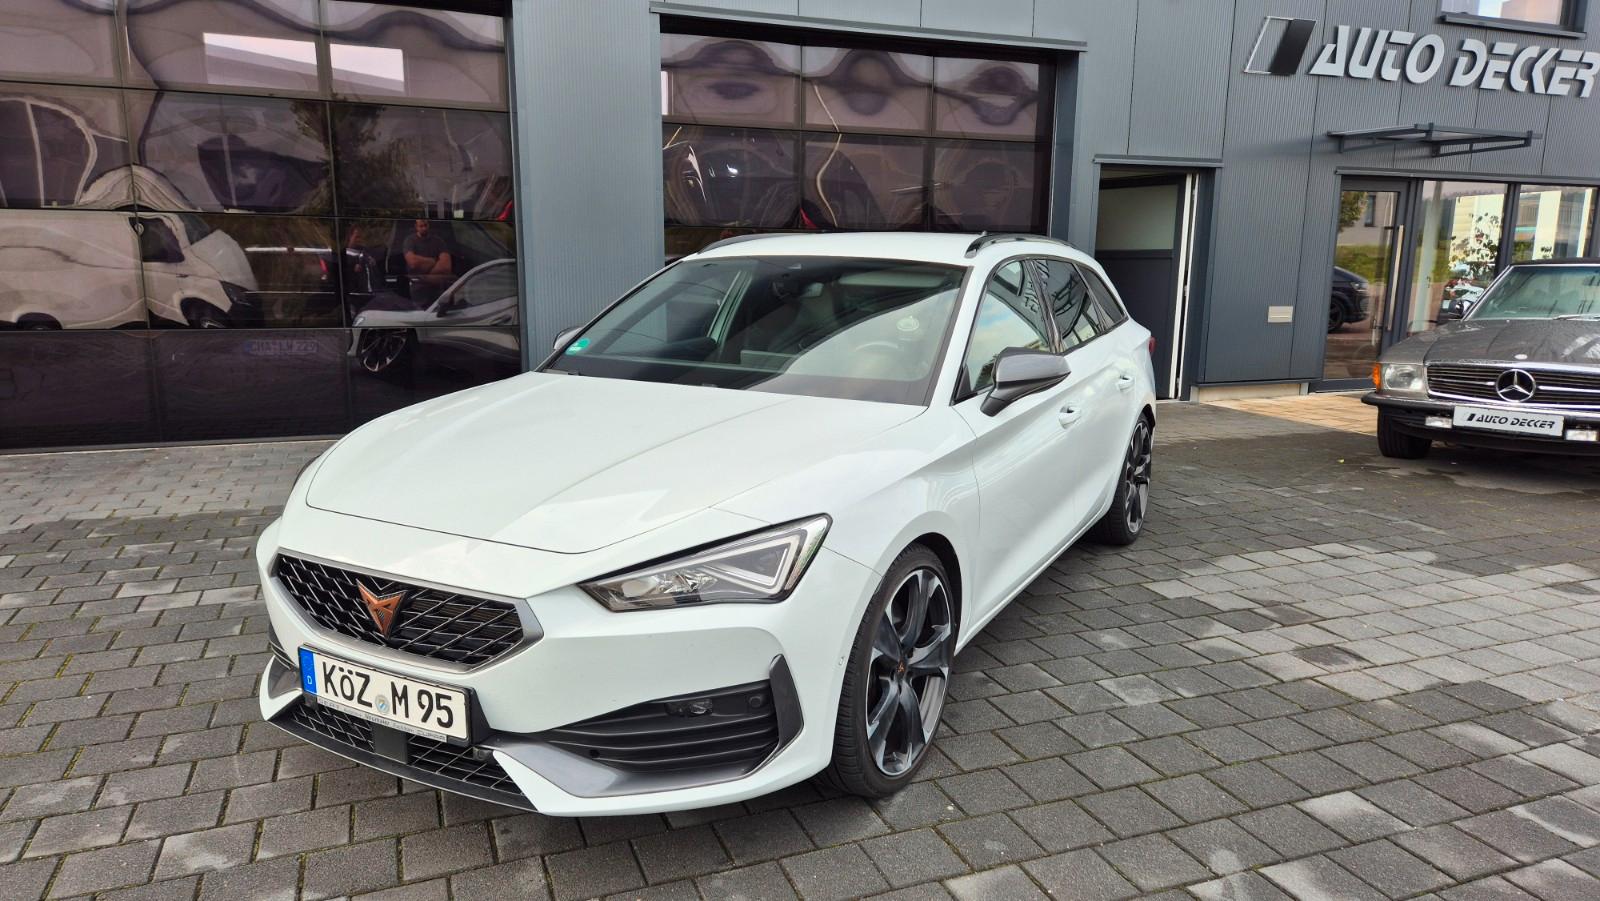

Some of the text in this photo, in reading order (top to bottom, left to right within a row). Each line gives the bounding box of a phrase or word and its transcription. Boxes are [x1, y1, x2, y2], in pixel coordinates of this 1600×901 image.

[1309, 25, 1600, 98] AUTO DECKER
[1476, 415, 1555, 429] AUTO DECKER
[322, 661, 373, 709] KÖZ
[391, 681, 410, 719] M
[417, 689, 454, 729] 95
